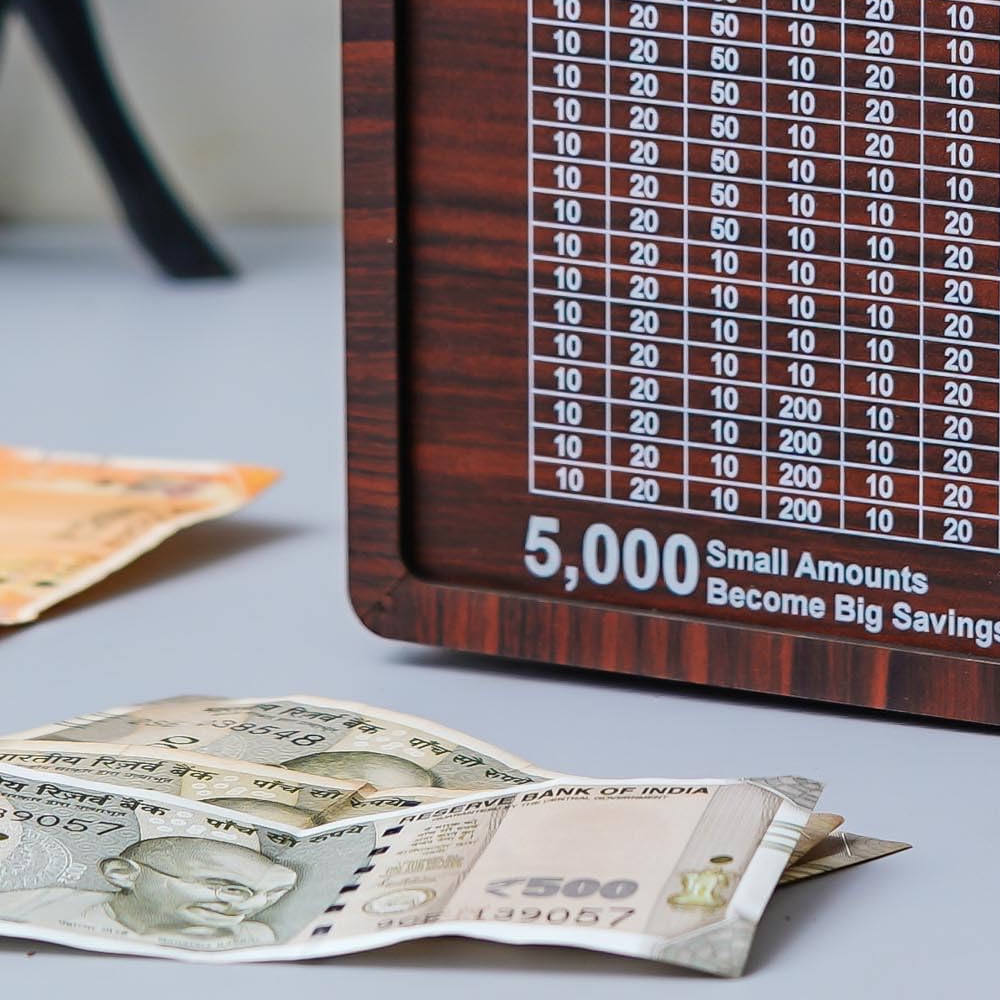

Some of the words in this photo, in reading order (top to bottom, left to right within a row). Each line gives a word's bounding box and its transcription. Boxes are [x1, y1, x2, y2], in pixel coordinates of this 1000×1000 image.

[629, 3, 659, 30] 20
[710, 11, 740, 38] 50
[787, 21, 816, 47] 10
[865, 29, 895, 56] 20
[946, 38, 975, 65] 10
[553, 63, 581, 89] 10
[629, 71, 659, 98] 20
[710, 79, 740, 106] 50
[787, 89, 816, 116] 10
[864, 98, 895, 125] 20
[946, 107, 974, 134] 10
[553, 130, 582, 157] 10
[629, 139, 659, 166] 20
[710, 147, 740, 174] 50
[787, 157, 816, 184] 10
[866, 166, 895, 193] 10
[946, 175, 974, 202] 10
[553, 198, 582, 224] 10
[629, 207, 659, 233] 20
[710, 215, 740, 242] 50
[787, 226, 816, 252] 10
[866, 235, 895, 261] 10
[944, 244, 974, 271] 20
[553, 299, 582, 325] 10
[629, 308, 660, 335] 20
[710, 317, 739, 344] 10
[787, 327, 816, 354] 10
[866, 337, 894, 364] 10
[943, 346, 974, 373] 20
[553, 399, 583, 426] 10
[629, 409, 660, 436] 20
[710, 419, 739, 445] 10
[778, 428, 822, 456] 200
[866, 439, 894, 465] 10
[942, 448, 973, 474] 20
[555, 466, 585, 492] 10
[629, 476, 660, 503] 20
[710, 486, 739, 512] 10
[778, 495, 822, 524] 200
[865, 506, 894, 533] 10
[942, 516, 973, 543] 20
[523, 515, 699, 595] 5,000
[706, 539, 789, 576] Small
[795, 552, 929, 595] Amounts
[706, 577, 826, 619] Become
[834, 594, 884, 634] Big
[119, 796, 171, 817] बैंक
[399, 794, 516, 824] RESERVE
[521, 786, 595, 803] BANK
[599, 786, 637, 796] OF
[641, 786, 710, 795] INDIA
